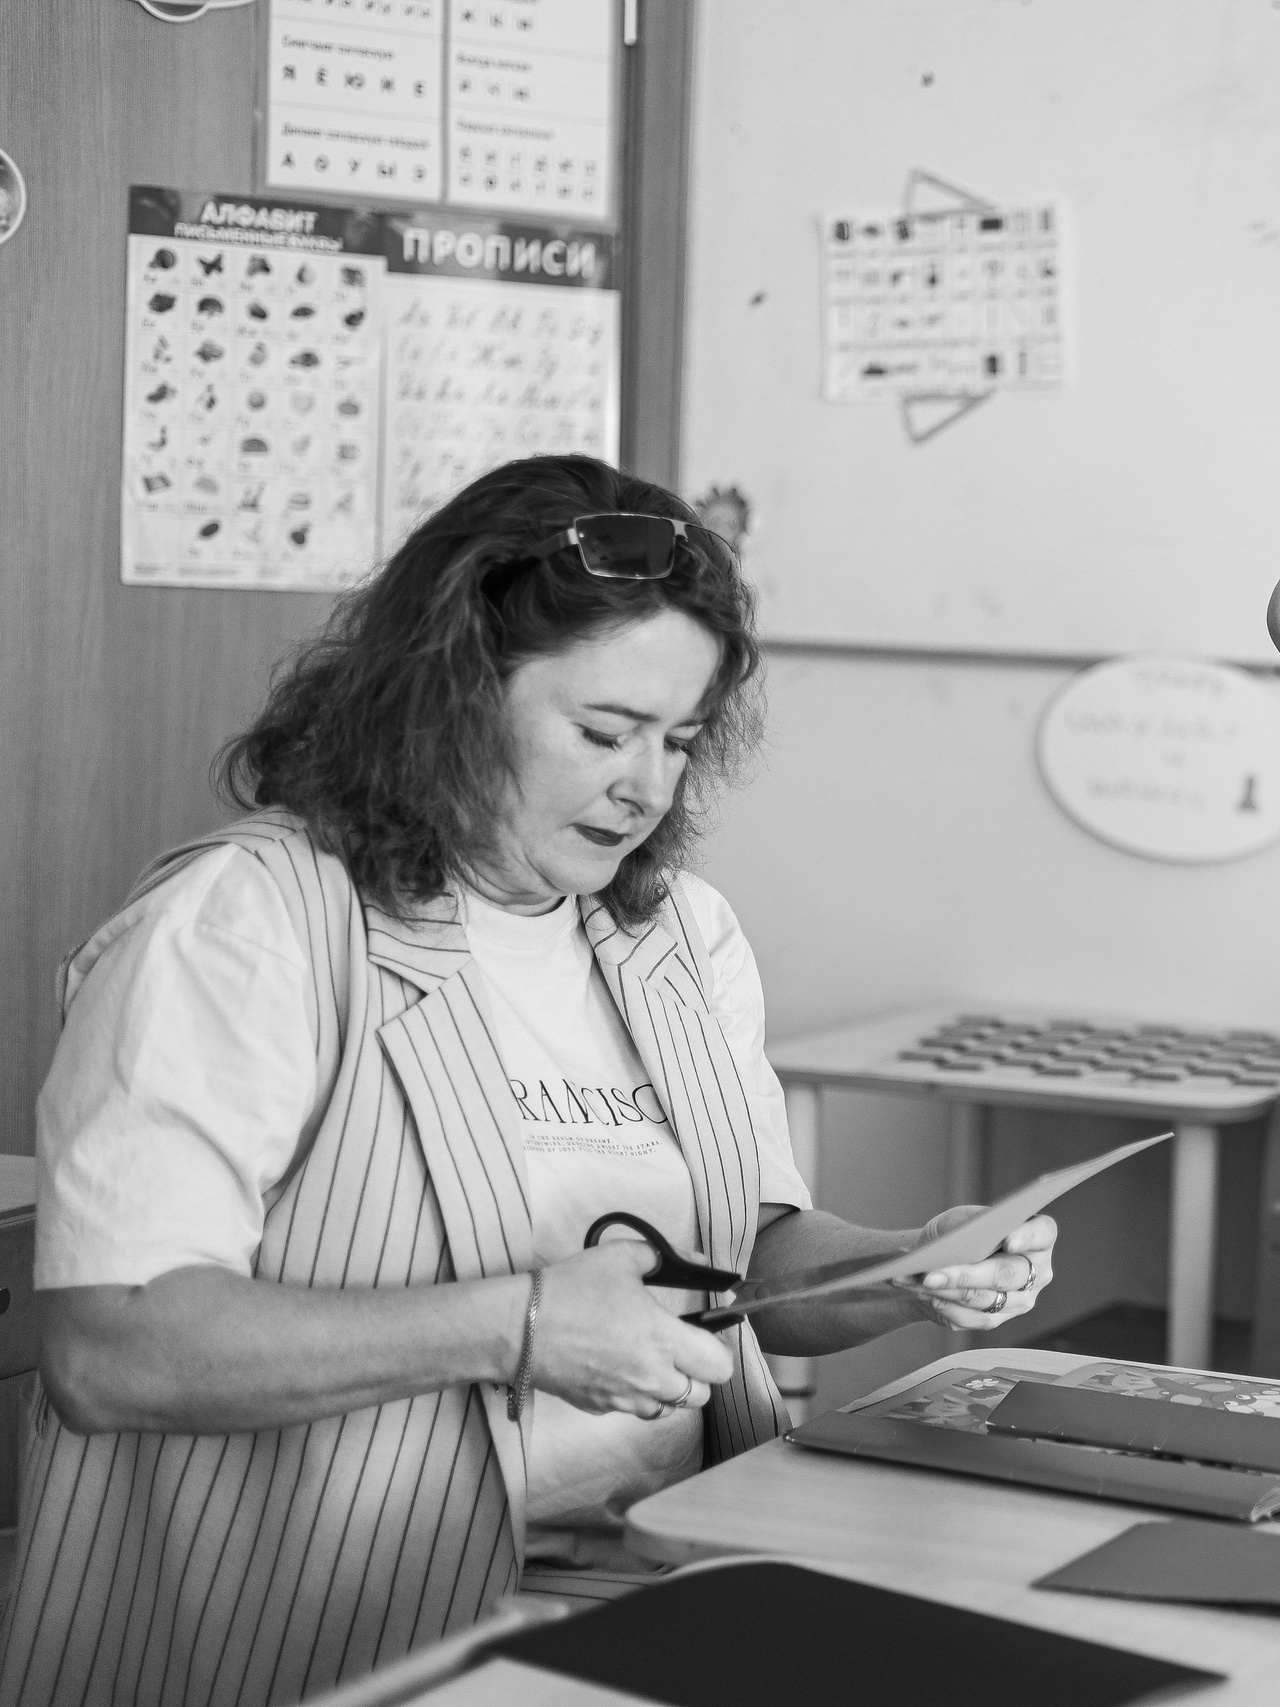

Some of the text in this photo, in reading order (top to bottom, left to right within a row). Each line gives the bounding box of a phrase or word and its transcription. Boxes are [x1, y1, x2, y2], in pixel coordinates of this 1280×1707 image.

[344, 71, 365, 90] Ю
[282, 152, 295, 168] А
[314, 153, 329, 172] О
[377, 160, 397, 179] Ы
[201, 201, 319, 233] АЛФАВИТ
[403, 227, 596, 278] ПРОПИСИ
